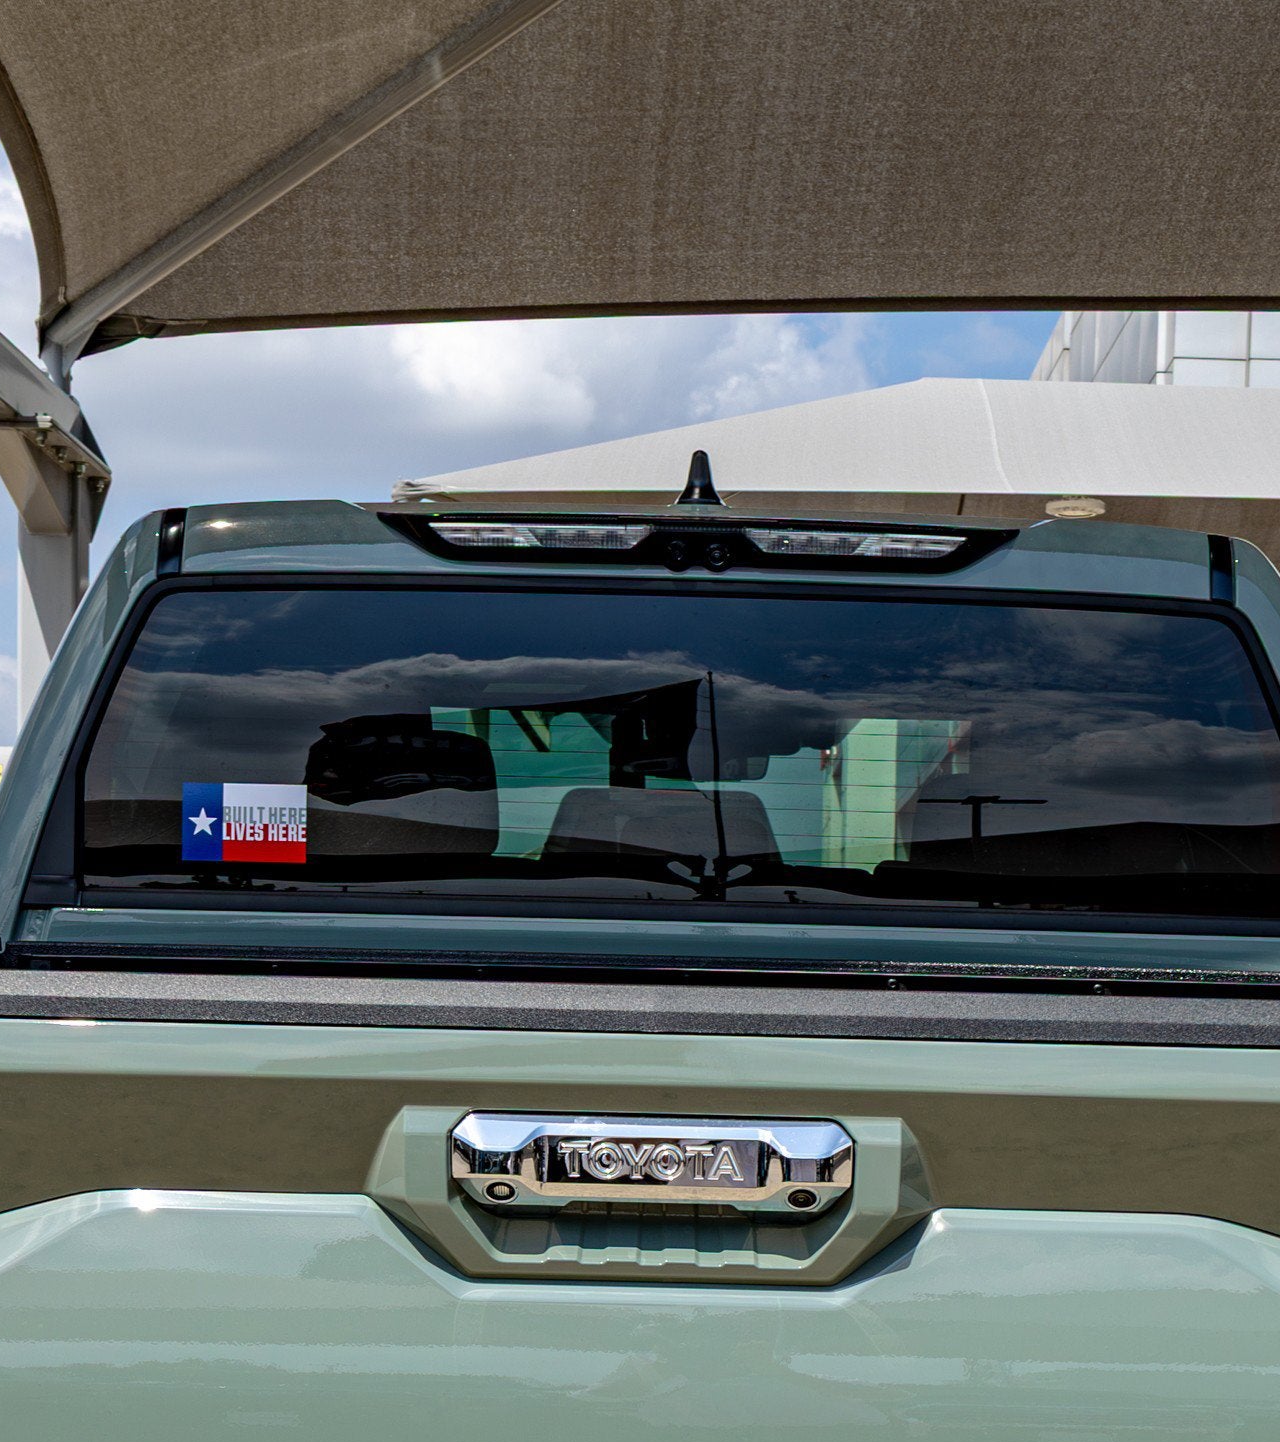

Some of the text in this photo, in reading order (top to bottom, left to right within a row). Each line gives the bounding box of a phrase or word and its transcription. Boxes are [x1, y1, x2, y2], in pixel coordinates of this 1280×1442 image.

[223, 806, 307, 825] BUILT HERE
[222, 822, 307, 842] LIVES HERE
[557, 1140, 745, 1182] TOYOTA
